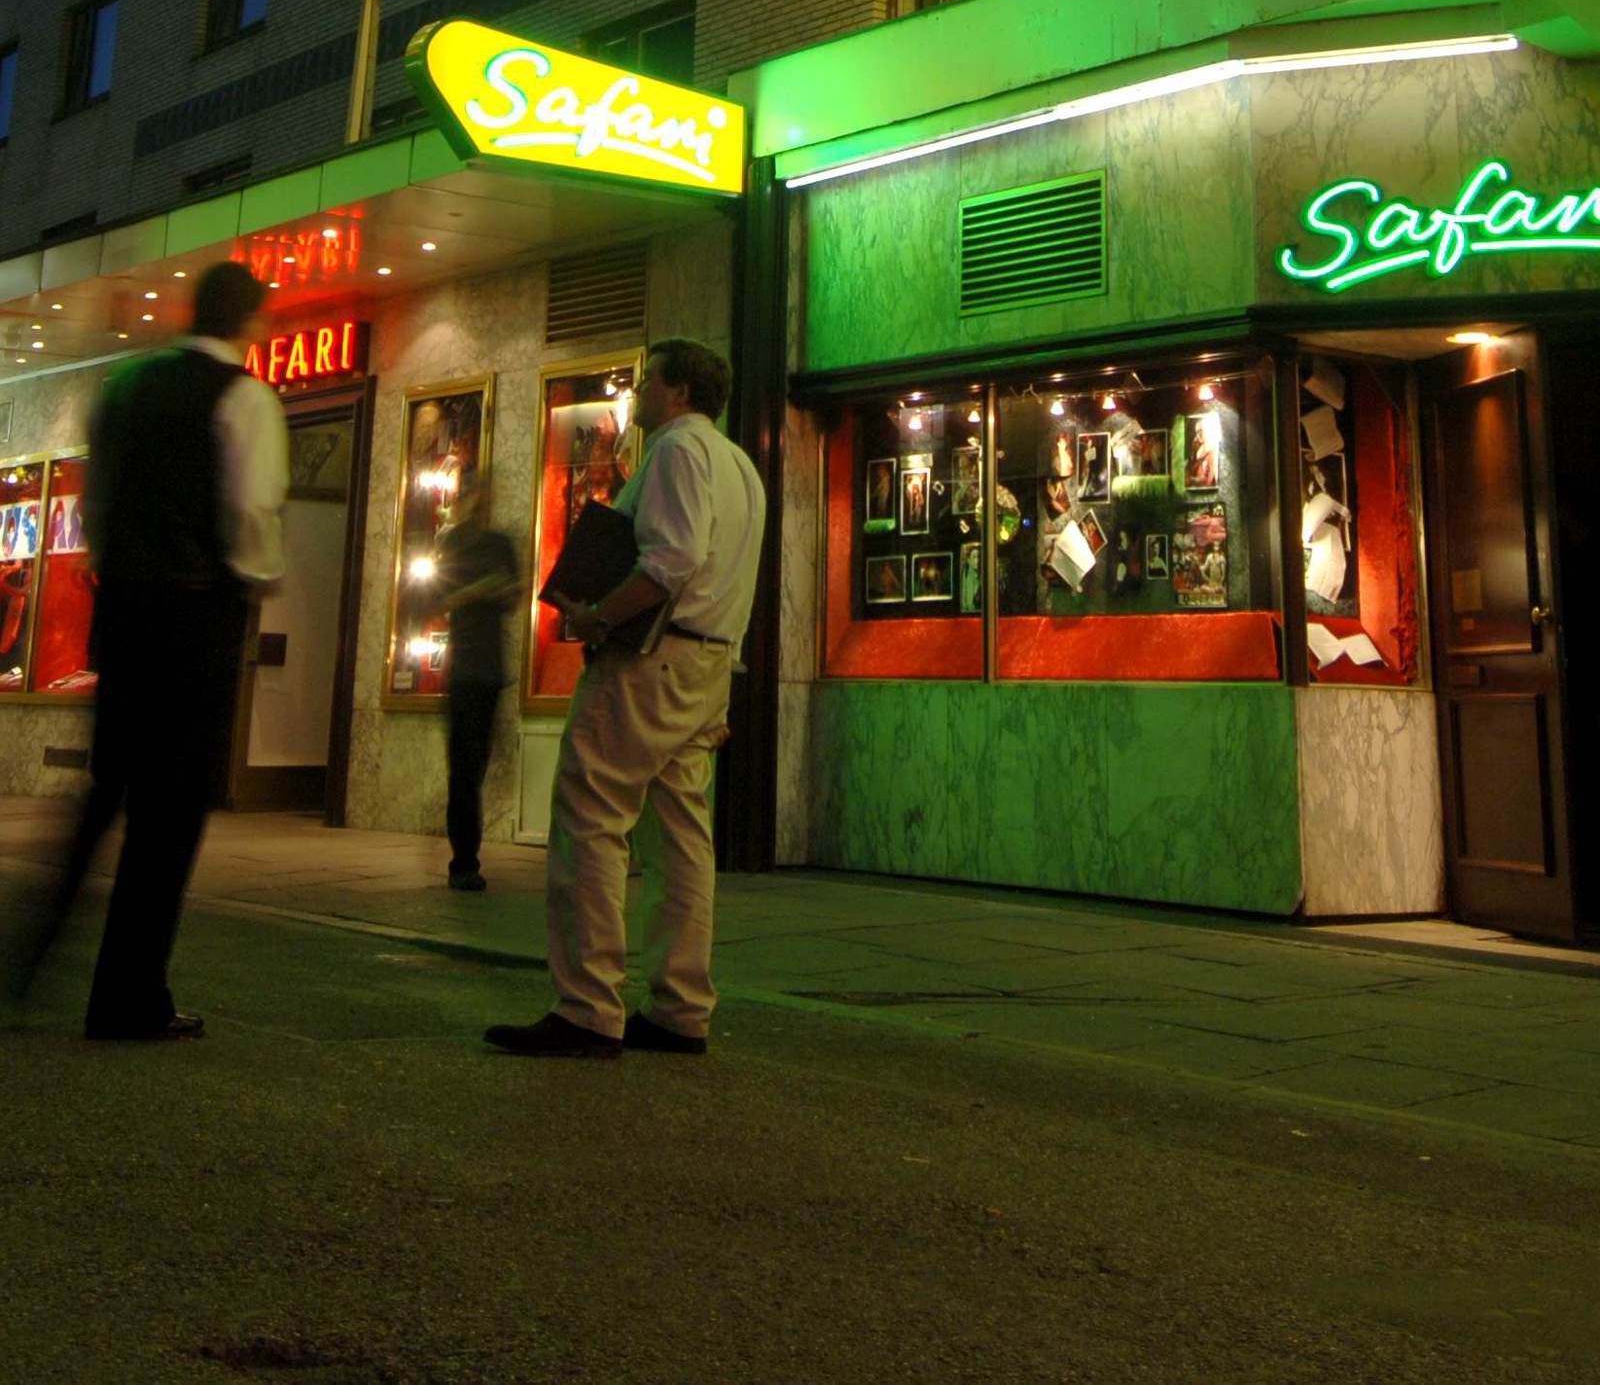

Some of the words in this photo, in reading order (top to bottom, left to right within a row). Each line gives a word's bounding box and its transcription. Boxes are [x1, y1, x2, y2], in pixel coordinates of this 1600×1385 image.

[465, 48, 728, 165] Safari
[1279, 160, 1600, 281] Safar
[244, 321, 354, 385] AFARI
